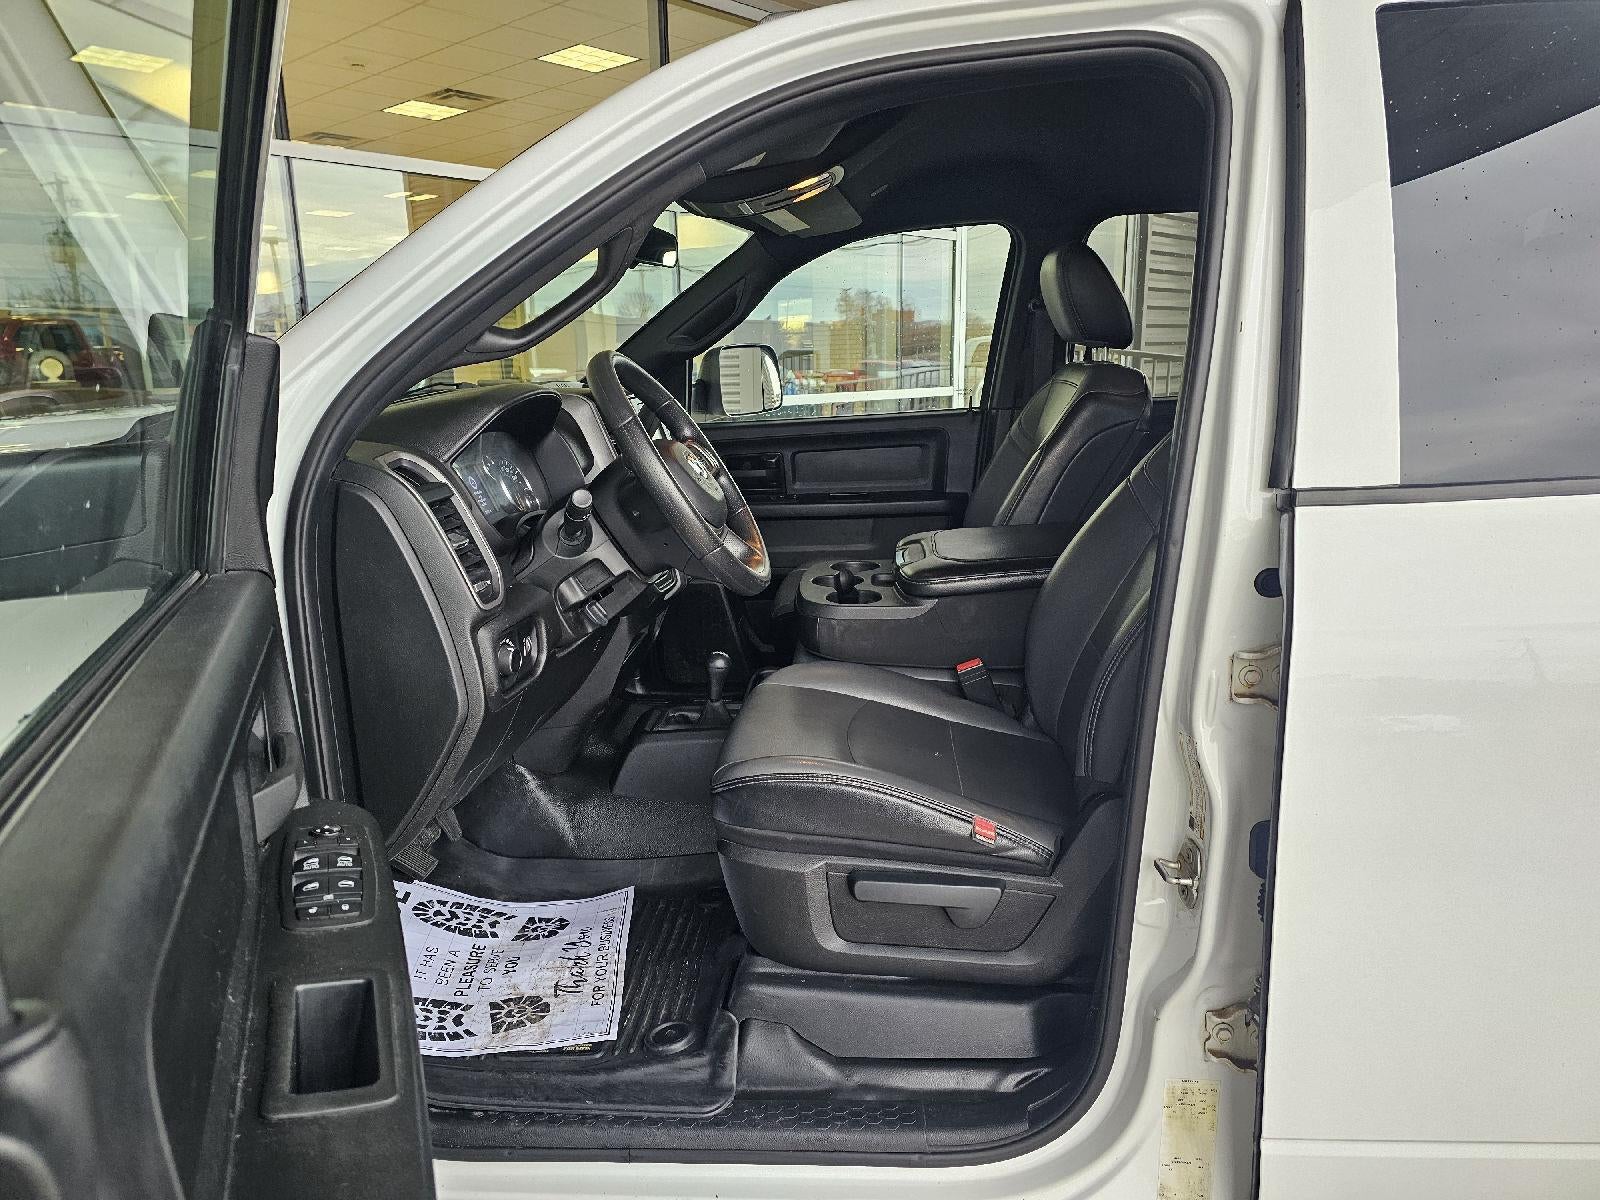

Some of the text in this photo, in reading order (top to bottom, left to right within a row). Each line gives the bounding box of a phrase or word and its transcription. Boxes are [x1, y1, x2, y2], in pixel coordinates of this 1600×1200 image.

[414, 946, 438, 980] IT HAS
[435, 950, 461, 985] BEEN A
[454, 943, 486, 997] PLEASURE
[477, 949, 504, 992] TO SERVE
[501, 956, 520, 976] YOU
[554, 952, 591, 998] Thank
[594, 954, 608, 984] YOUR
[590, 985, 605, 1007] FOR
